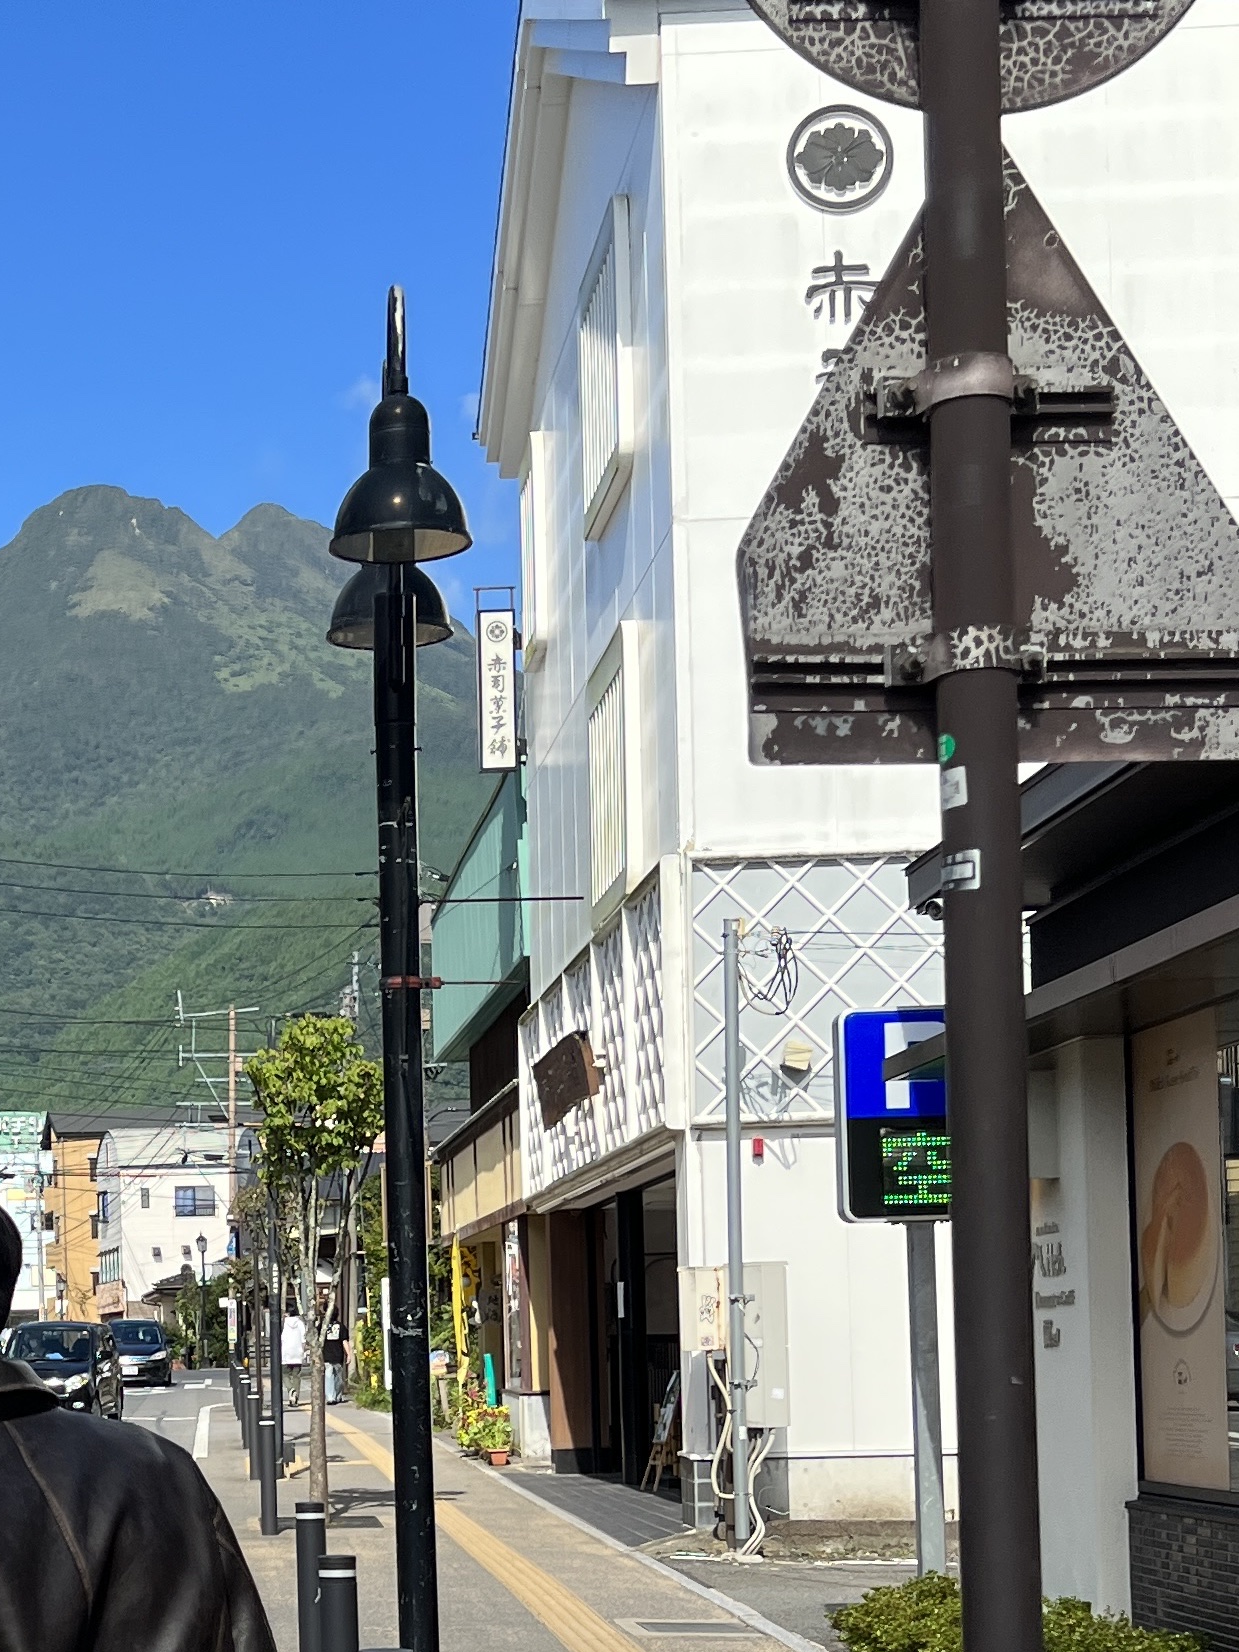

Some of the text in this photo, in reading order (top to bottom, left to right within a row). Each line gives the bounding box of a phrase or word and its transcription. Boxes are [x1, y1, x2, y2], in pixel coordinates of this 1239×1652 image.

[486, 652, 511, 760] 赤司菓子舗
[881, 1131, 952, 1205] 空
